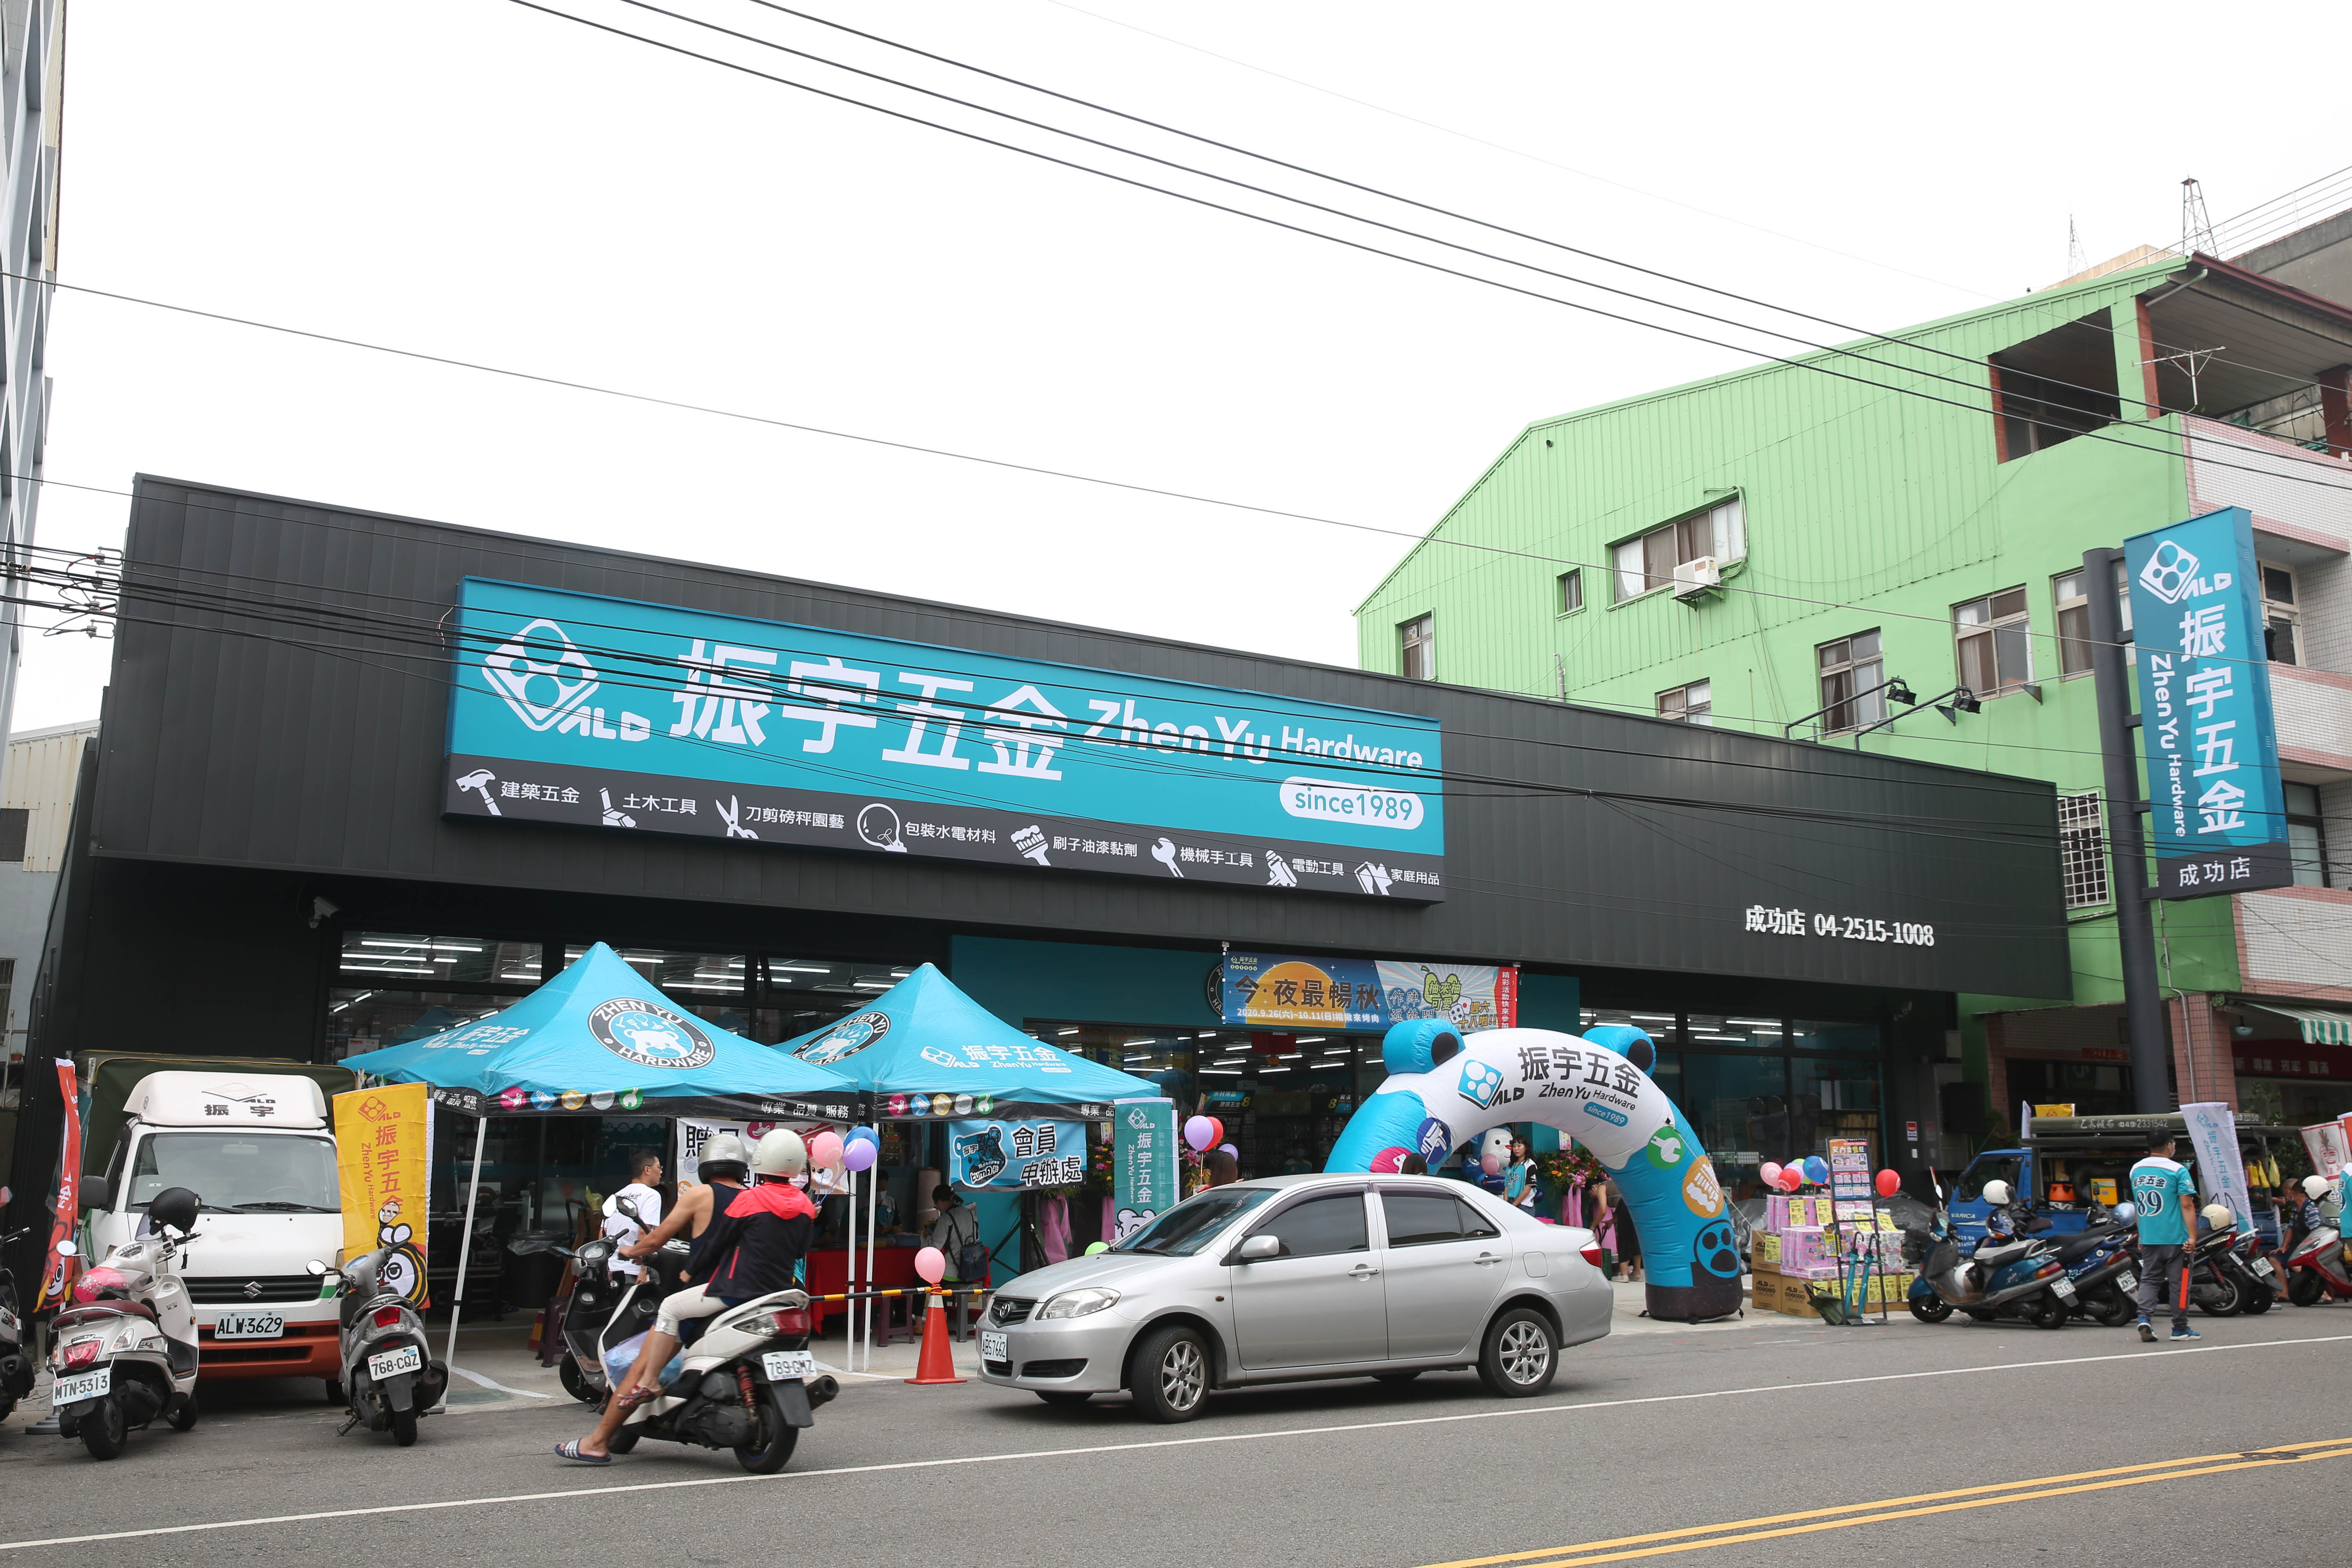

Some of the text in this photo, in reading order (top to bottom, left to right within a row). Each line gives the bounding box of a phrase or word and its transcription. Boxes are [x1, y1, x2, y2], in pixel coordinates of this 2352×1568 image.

[669, 639, 1067, 781] 振宇五金
[2178, 604, 2245, 835] 振宇五金
[1281, 726, 1422, 771] Hardware
[501, 780, 580, 804] 建築五金
[2163, 753, 2186, 837] Hardware
[623, 793, 698, 816] 土木工具
[1295, 787, 1412, 821] since1989
[745, 806, 845, 830] 刀剪磅秤園藝
[904, 820, 996, 845] 包裝水電材料
[1053, 836, 1138, 858] 刷子油漆黏劑
[1180, 846, 1254, 868] 機械手工具
[1292, 858, 1344, 877] 電動工具
[1391, 868, 1440, 887] 家庭用品
[2179, 856, 2250, 887] 成功店
[1745, 905, 1935, 947] 成功店 04-2515-1008
[1390, 989, 1420, 1007] 作陣
[1428, 981, 1461, 995] 柚來柚
[595, 1001, 683, 1023] ZHEN YU
[1431, 998, 1453, 1011] 可愛
[1470, 1001, 1490, 1013] 週六
[834, 1013, 886, 1033] ZHEN YU
[618, 1047, 710, 1067] HARDWARE
[962, 1045, 1061, 1061] 振宇五金
[1517, 1047, 1640, 1098] 振宇五金
[761, 1101, 849, 1119] 專業 品質 服務
[1081, 1104, 1100, 1116] 專業
[1242, 1097, 1251, 1107] 8
[1328, 1098, 1337, 1108] 8
[1592, 1089, 1635, 1110] Hardware
[1587, 1105, 1625, 1124] since1989
[963, 1144, 978, 1156] 振宇
[1012, 1125, 1057, 1158] 會員
[1021, 1156, 1081, 1185] 申辦處
[1137, 1132, 1152, 1203] 振宇五金
[368, 1185, 376, 1219] Hardware
[2137, 1190, 2163, 1216] 89
[371, 1354, 419, 1376] 768-CQZ
[55, 1374, 107, 1400] MTN-5313
